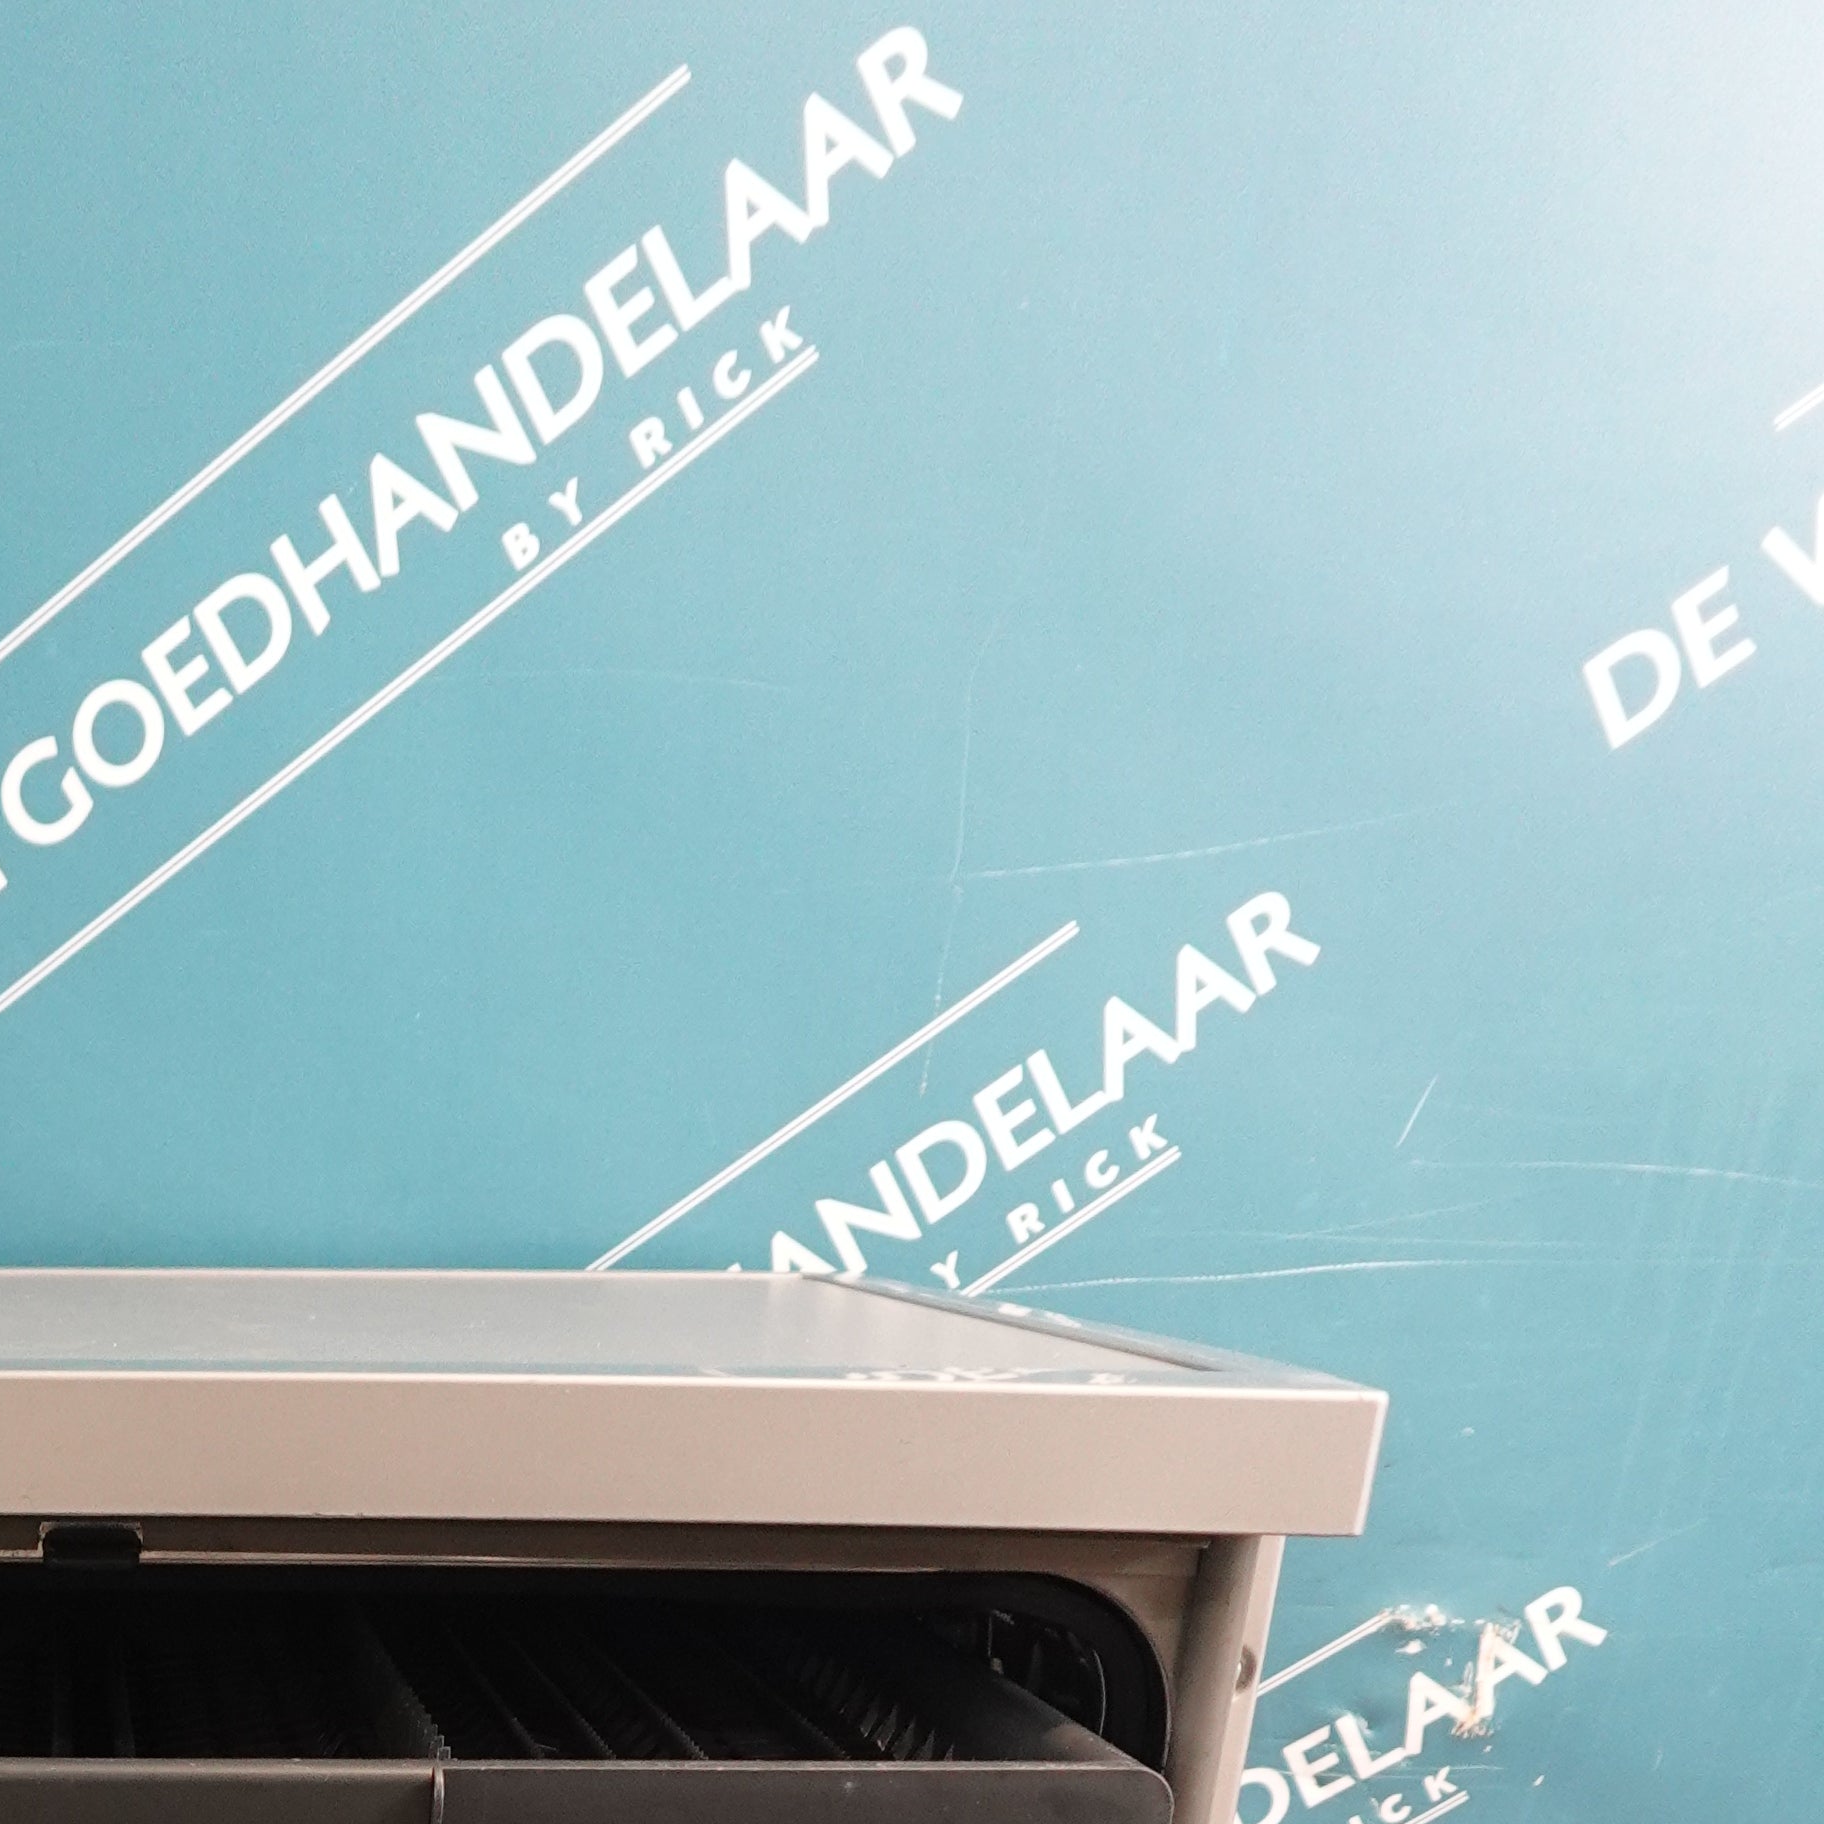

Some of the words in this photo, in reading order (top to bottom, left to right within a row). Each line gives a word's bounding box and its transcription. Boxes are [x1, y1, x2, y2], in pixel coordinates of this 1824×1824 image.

[501, 476, 583, 572] BY
[628, 305, 804, 470] RICK
[1582, 564, 1758, 751] DE
[1005, 1114, 1169, 1244] RICK
